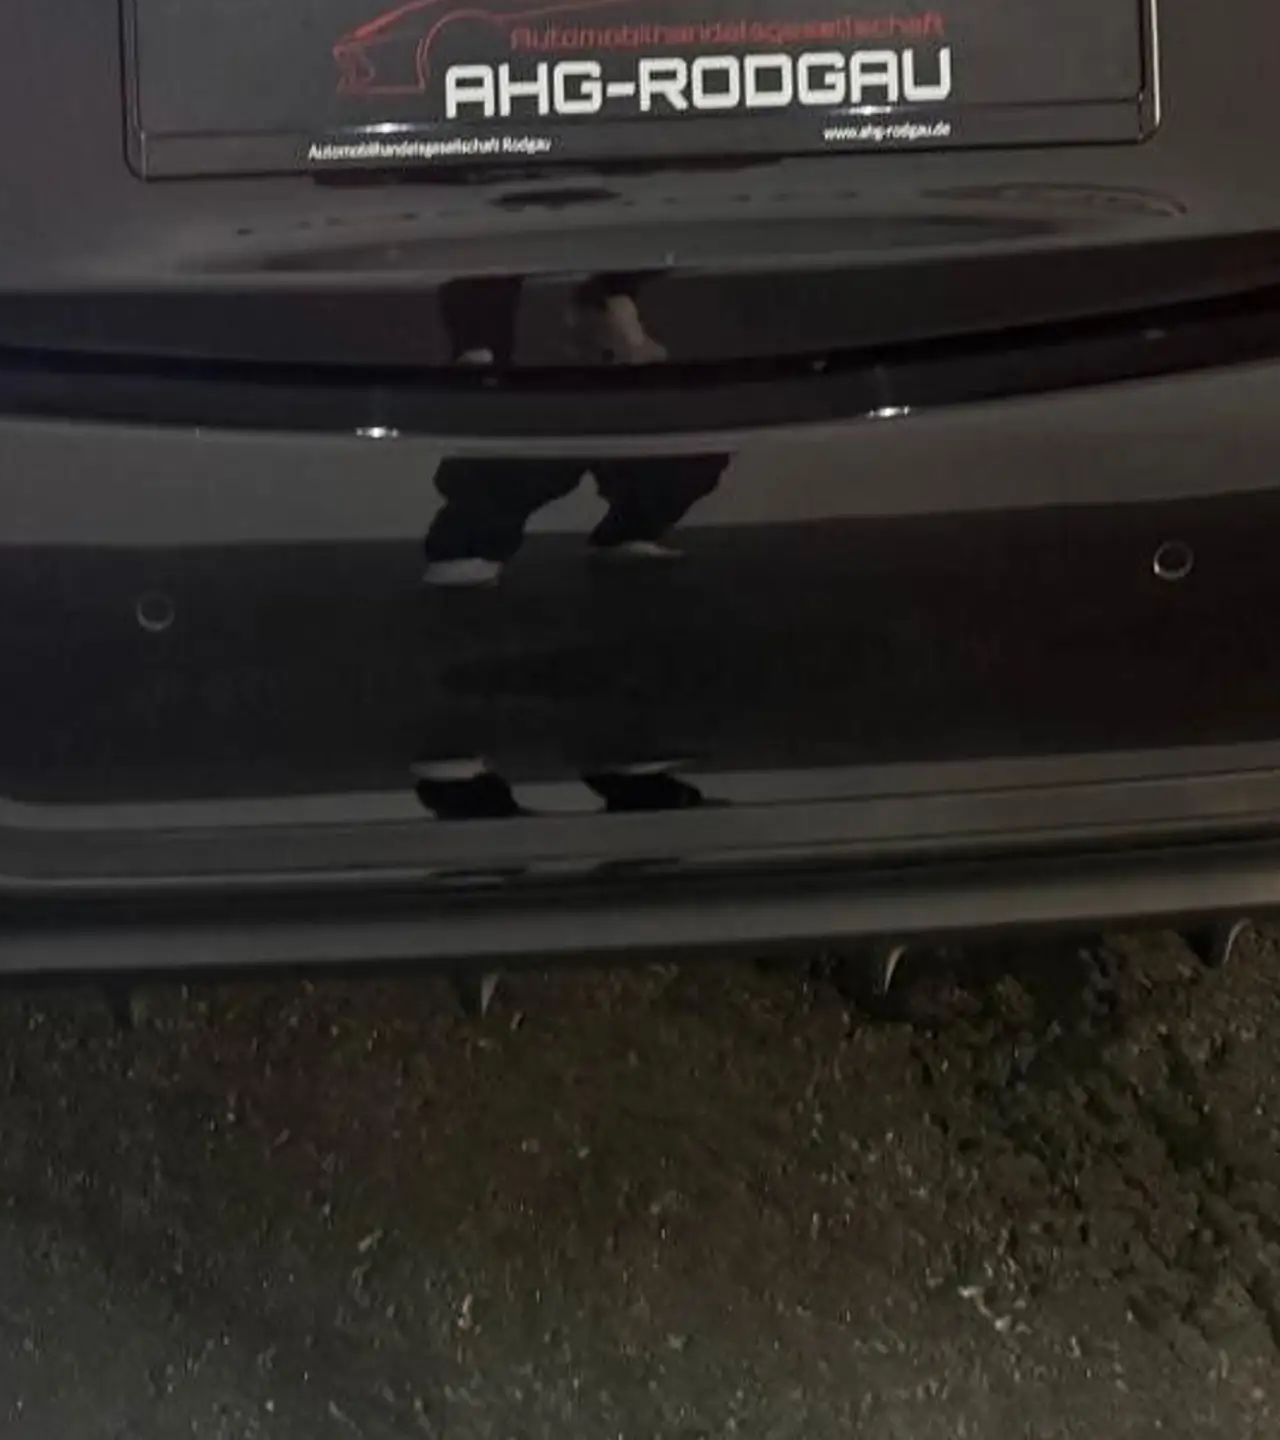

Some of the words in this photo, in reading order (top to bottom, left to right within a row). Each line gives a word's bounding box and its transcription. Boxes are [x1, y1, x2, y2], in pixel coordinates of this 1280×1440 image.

[509, 12, 946, 50] Automobilhandelsgesellschaft
[444, 46, 952, 120] AHG-RODGAU
[502, 135, 552, 155] Rodgau
